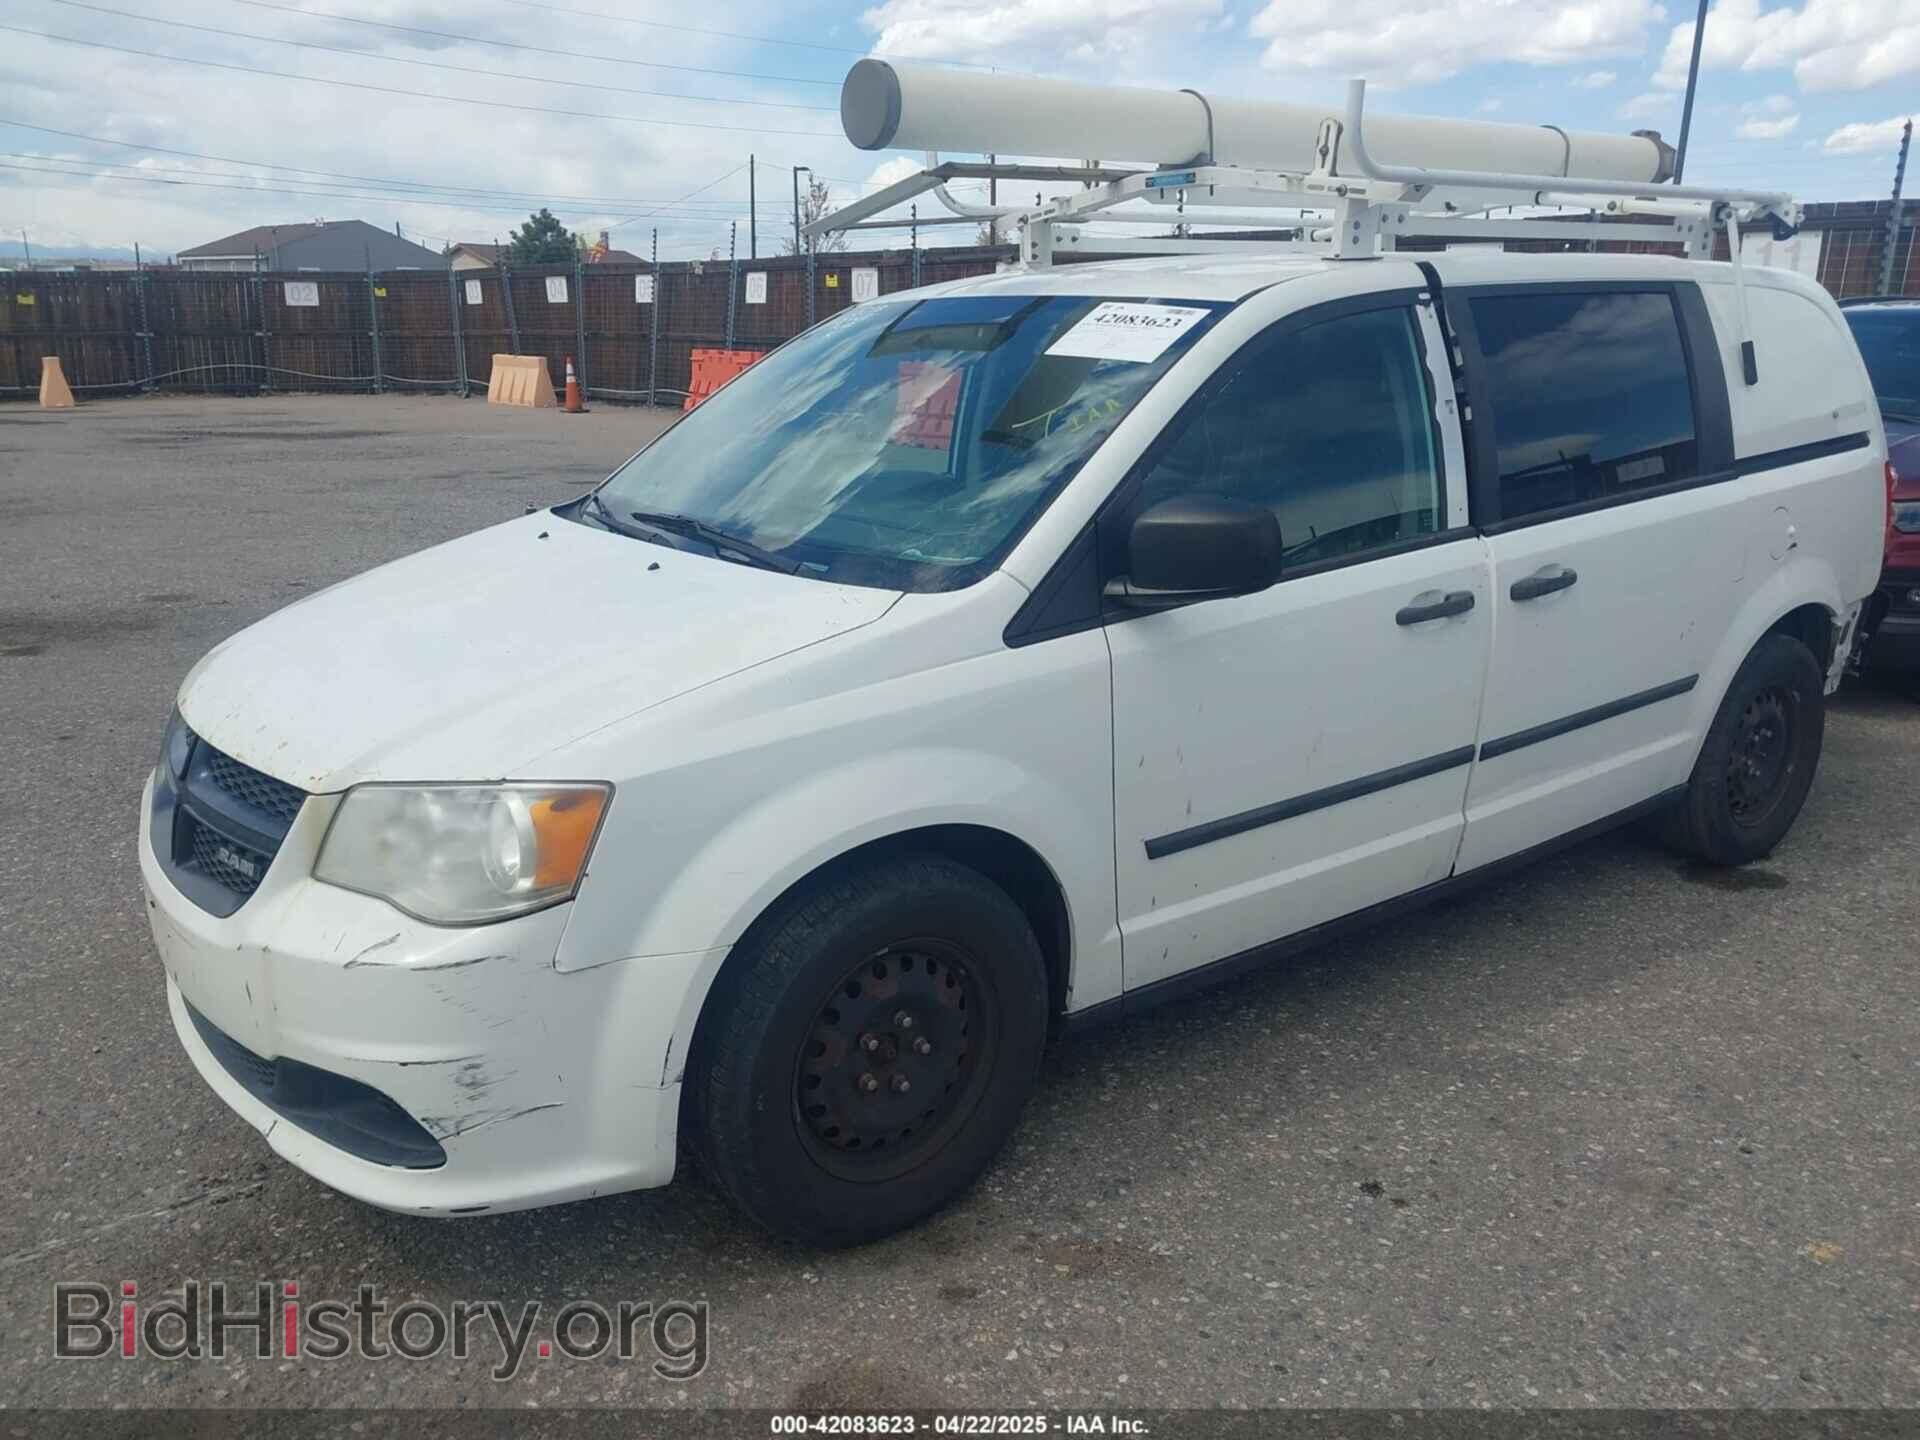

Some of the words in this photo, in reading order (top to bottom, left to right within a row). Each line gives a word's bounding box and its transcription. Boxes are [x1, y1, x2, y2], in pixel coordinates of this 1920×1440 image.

[290, 286, 314, 302] 02
[1094, 311, 1182, 329] 42083623
[218, 846, 255, 877] RAM
